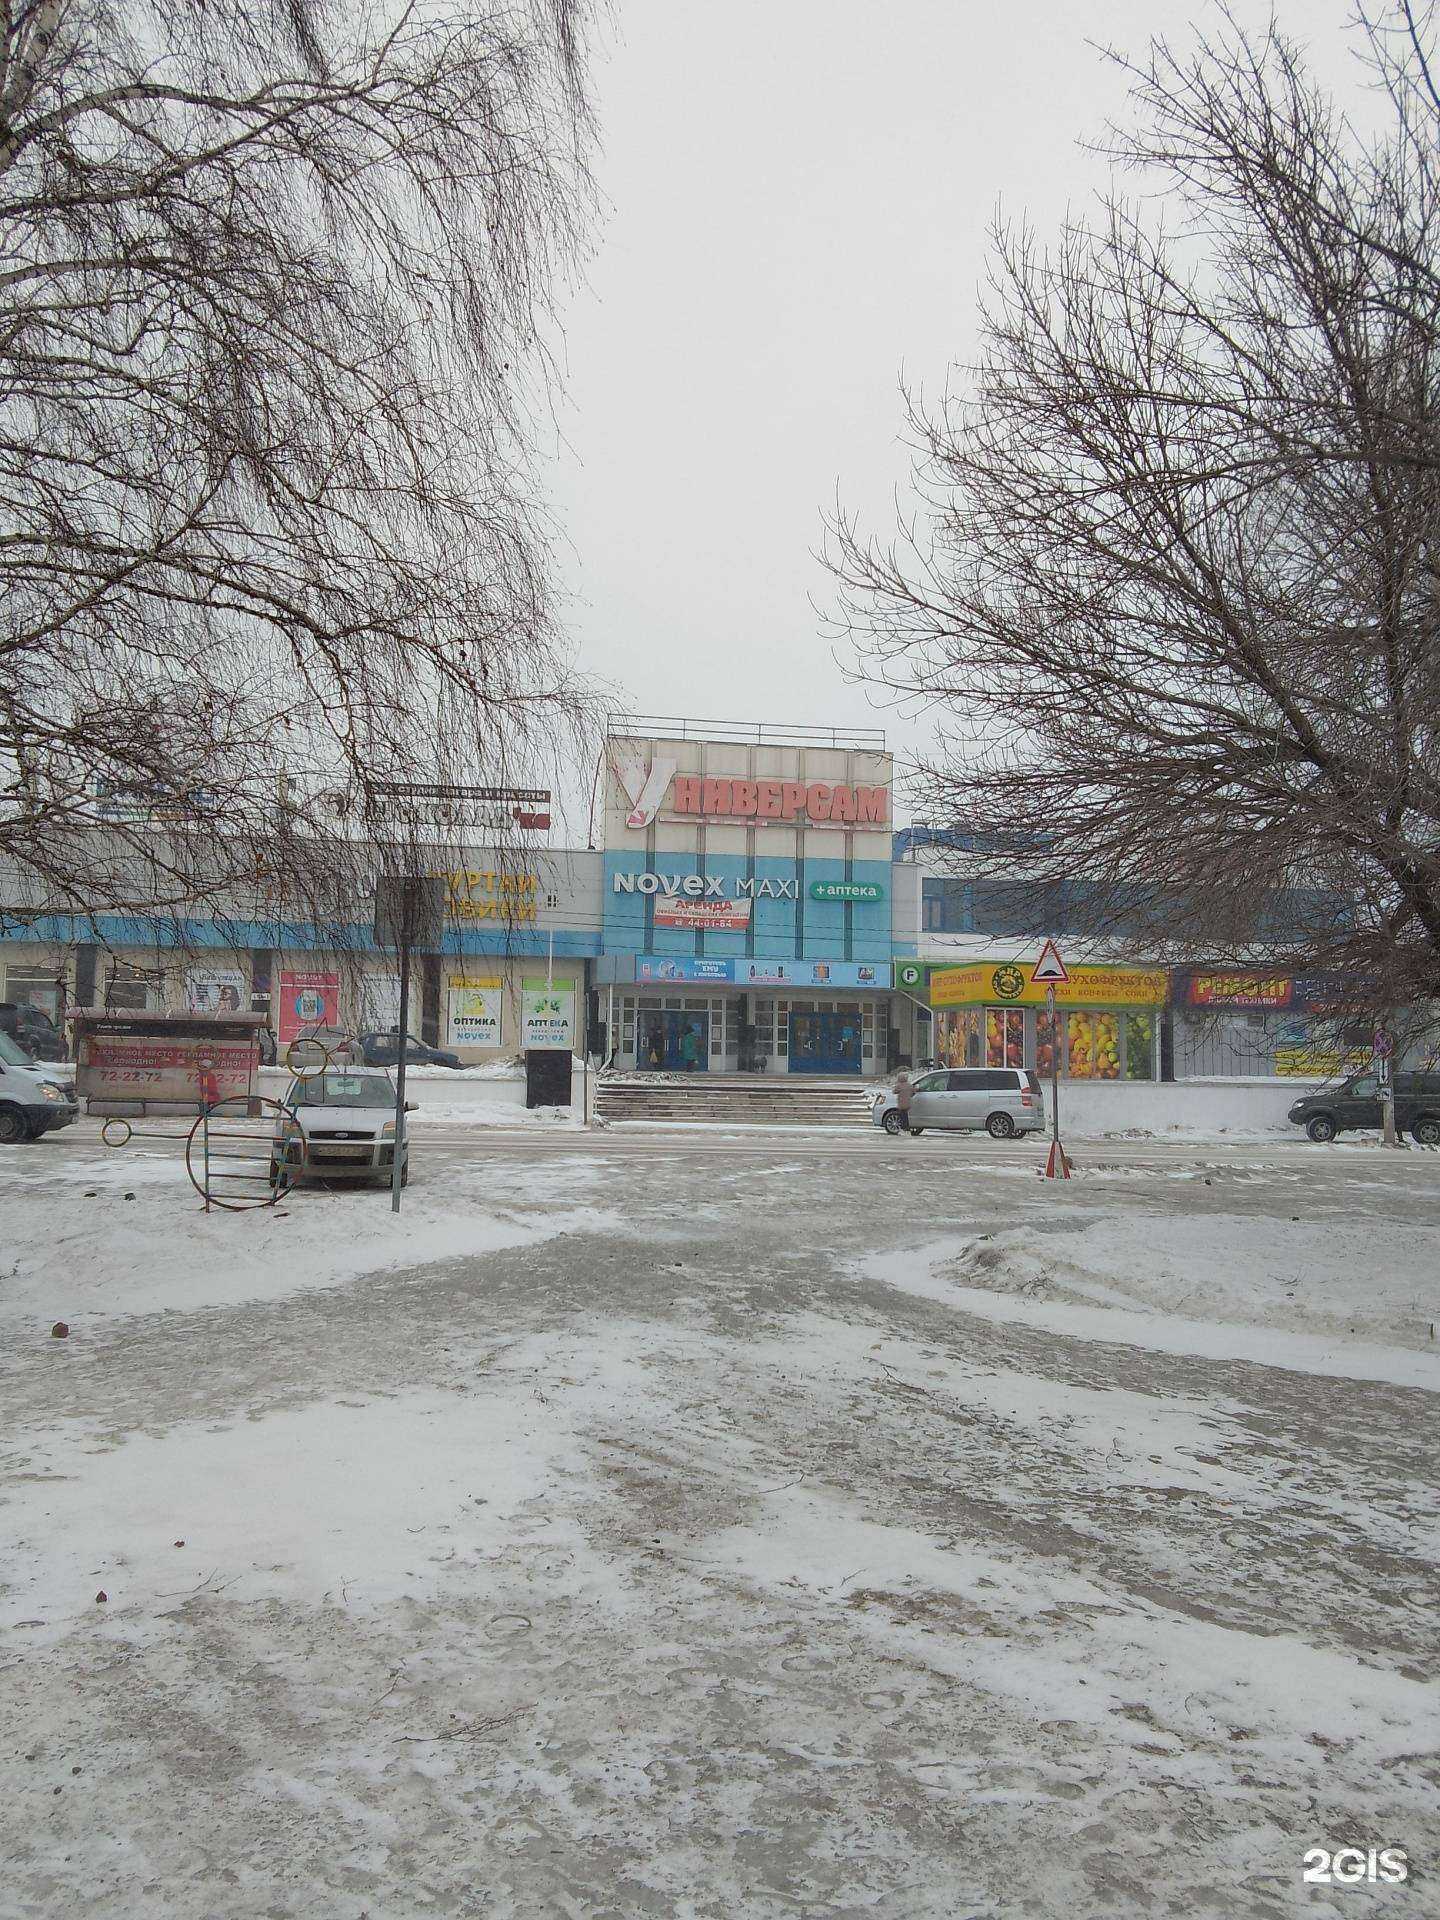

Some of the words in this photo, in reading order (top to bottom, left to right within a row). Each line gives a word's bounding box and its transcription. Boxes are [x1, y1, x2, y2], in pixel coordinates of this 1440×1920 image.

[611, 757, 888, 829] УНИВЕРСАМ
[735, 878, 799, 900] MAXI
[675, 899, 733, 912] АРЕНДА
[906, 970, 915, 981] F
[1067, 974, 1162, 987] УХОФРУКТОВ
[453, 1017, 497, 1026] ОПТИКА
[527, 1019, 569, 1028] АПТЕКА
[101, 1071, 162, 1083] 72-22-72
